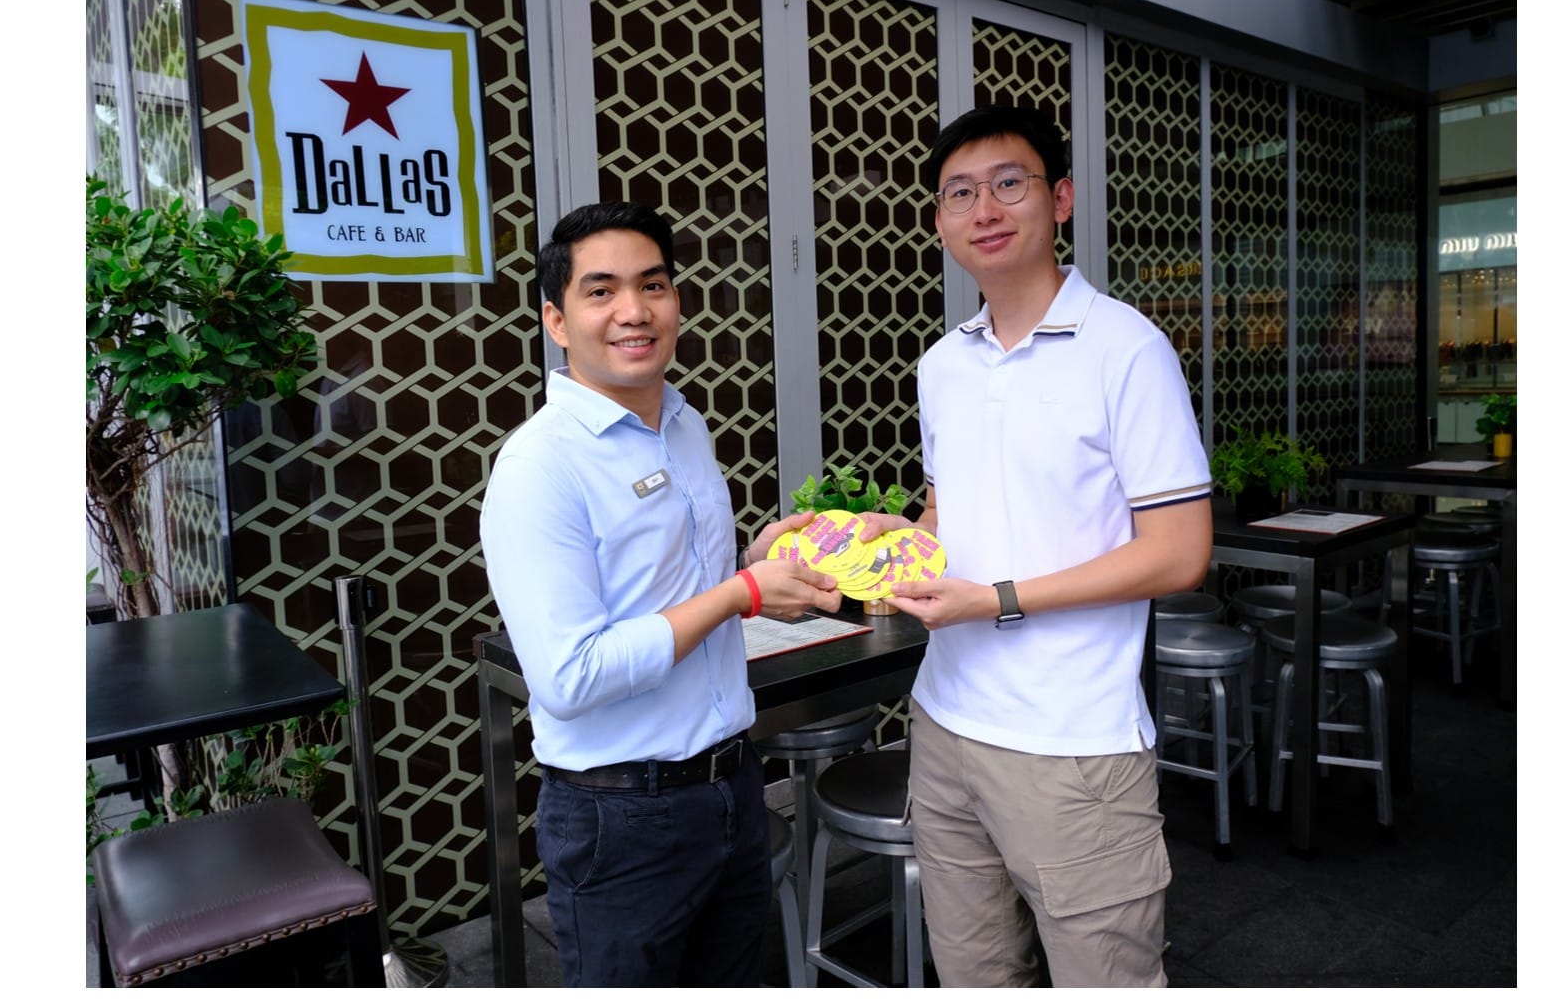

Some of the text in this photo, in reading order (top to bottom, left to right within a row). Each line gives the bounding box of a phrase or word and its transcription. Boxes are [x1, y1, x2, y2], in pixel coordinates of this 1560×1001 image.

[327, 224, 427, 245] CAFE & BAR
